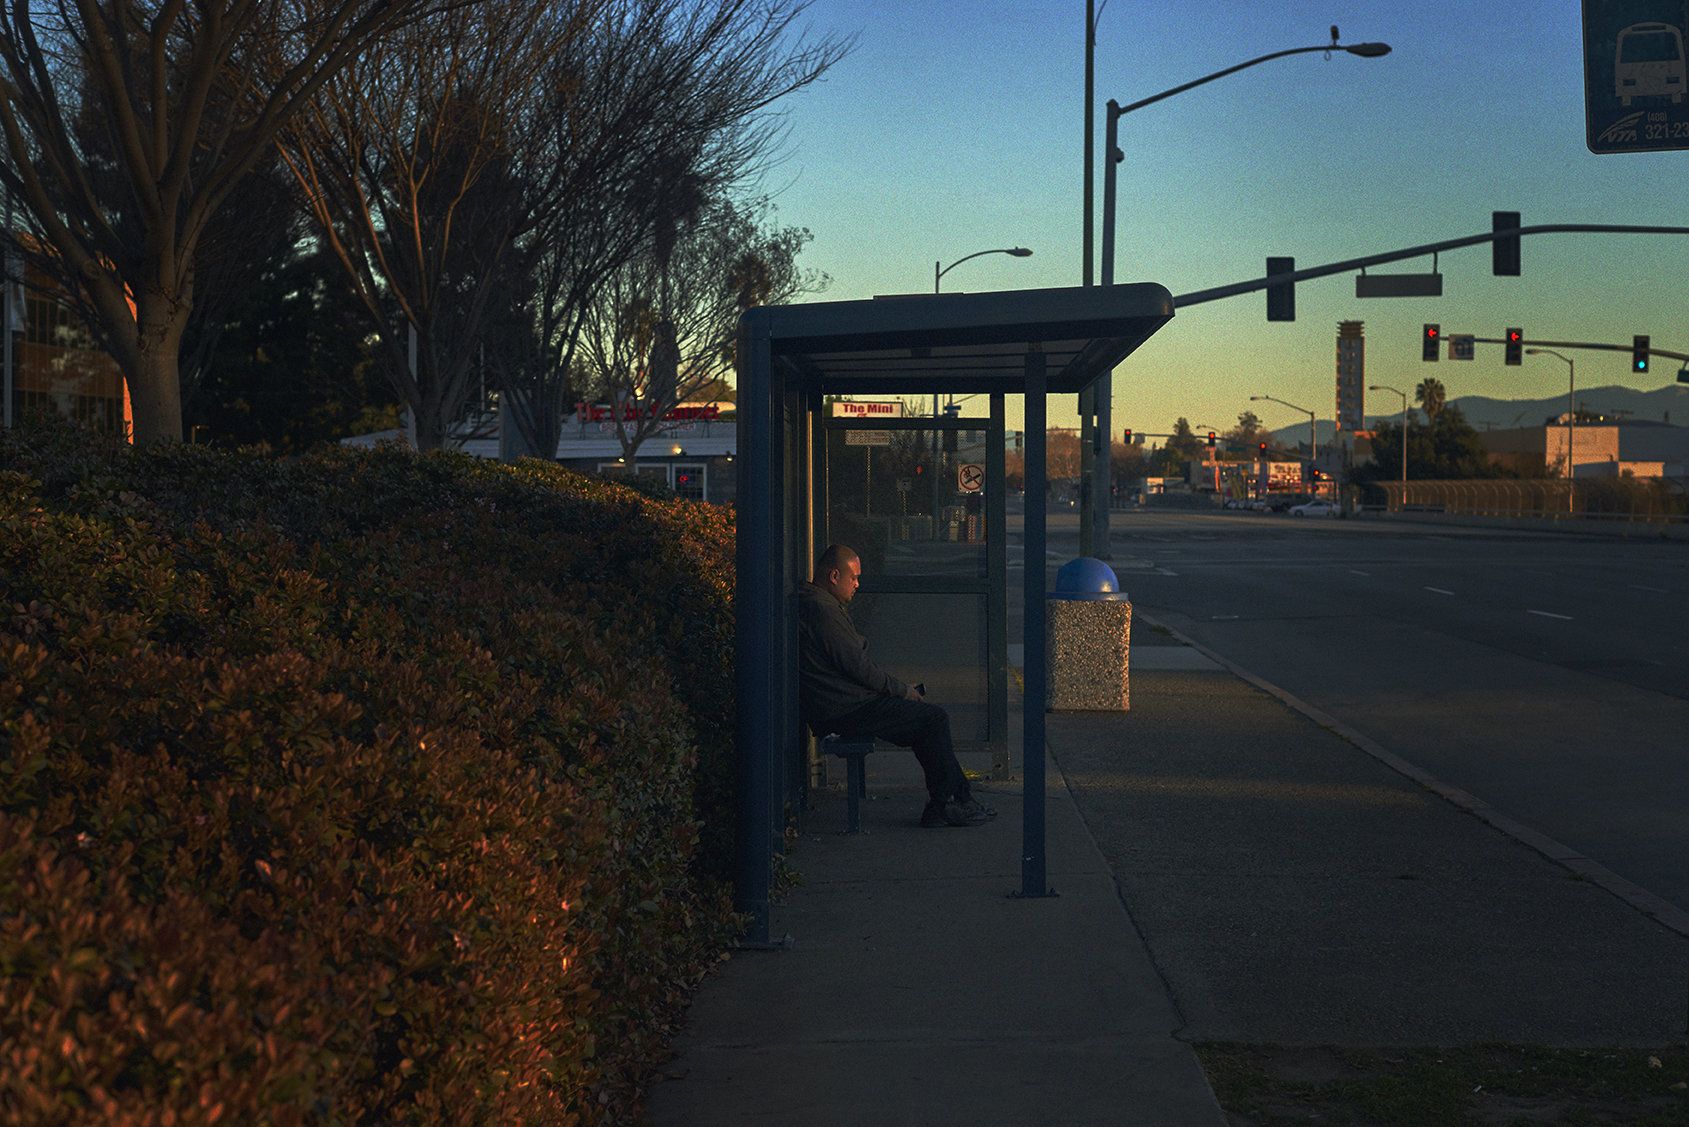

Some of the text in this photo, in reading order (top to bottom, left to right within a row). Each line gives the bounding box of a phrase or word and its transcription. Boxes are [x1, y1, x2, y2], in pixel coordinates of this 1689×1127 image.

[1645, 122, 1689, 140] 321-23
[843, 404, 893, 413] The Mini
